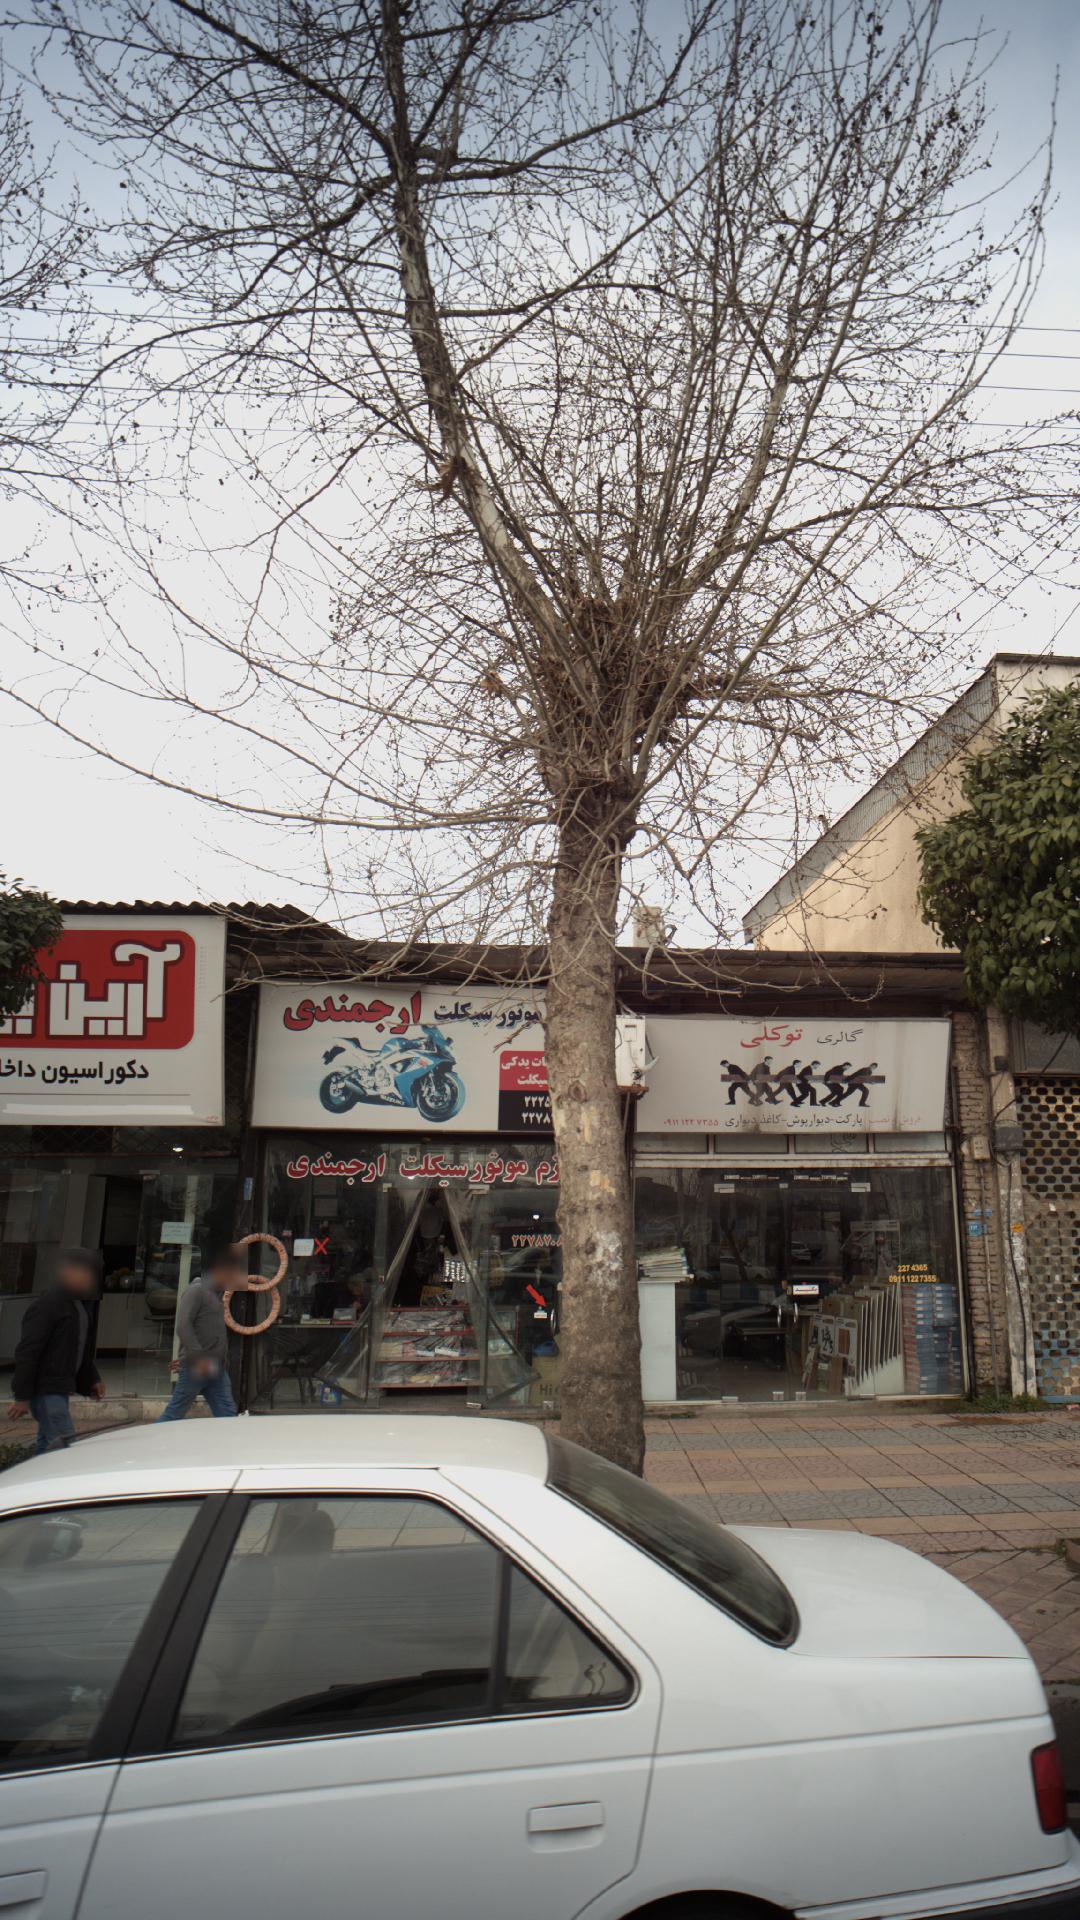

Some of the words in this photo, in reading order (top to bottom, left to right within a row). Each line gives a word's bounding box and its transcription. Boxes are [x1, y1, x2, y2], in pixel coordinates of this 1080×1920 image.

[283, 991, 422, 1034] ارجمندی
[740, 1023, 803, 1048] توکلی
[816, 1028, 863, 1045] گالری
[42, 1059, 149, 1084] دکوراسیون
[501, 1056, 530, 1070] یدکی
[521, 1112, 551, 1125] ۲۲۷۸
[286, 1152, 386, 1185] ارجمندی
